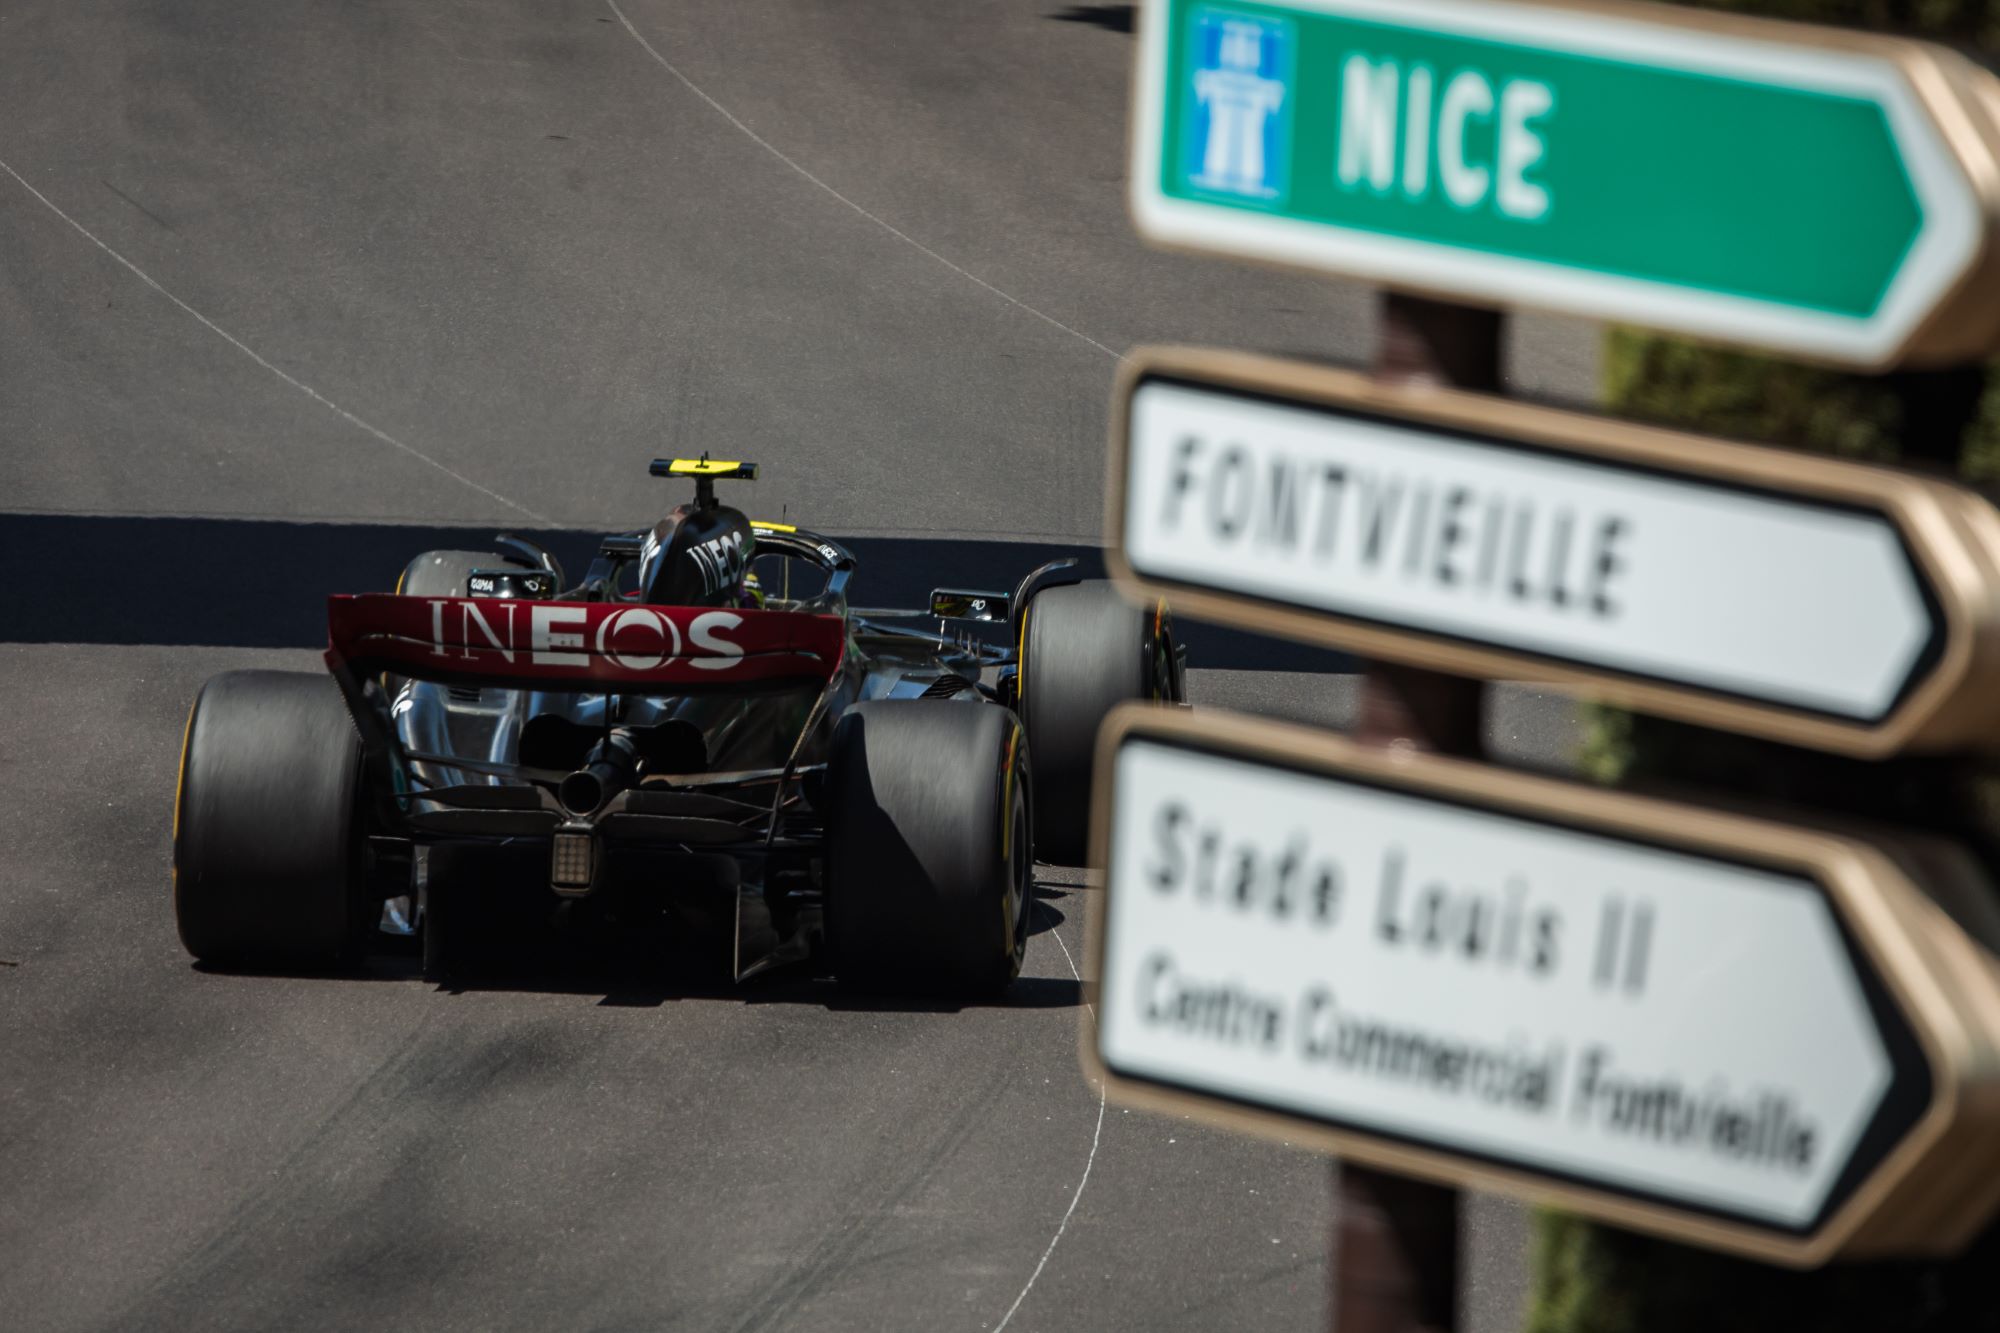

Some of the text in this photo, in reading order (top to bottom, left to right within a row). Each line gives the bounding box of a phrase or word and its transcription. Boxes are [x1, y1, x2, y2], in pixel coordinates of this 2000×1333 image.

[1336, 54, 1557, 219] NICE
[1160, 434, 1634, 618] FONTVIEILLE
[427, 599, 745, 670] INEOS
[1146, 801, 1656, 996] Stade Louis II
[1136, 950, 1817, 1174] Centre Commercial Fontvieille
